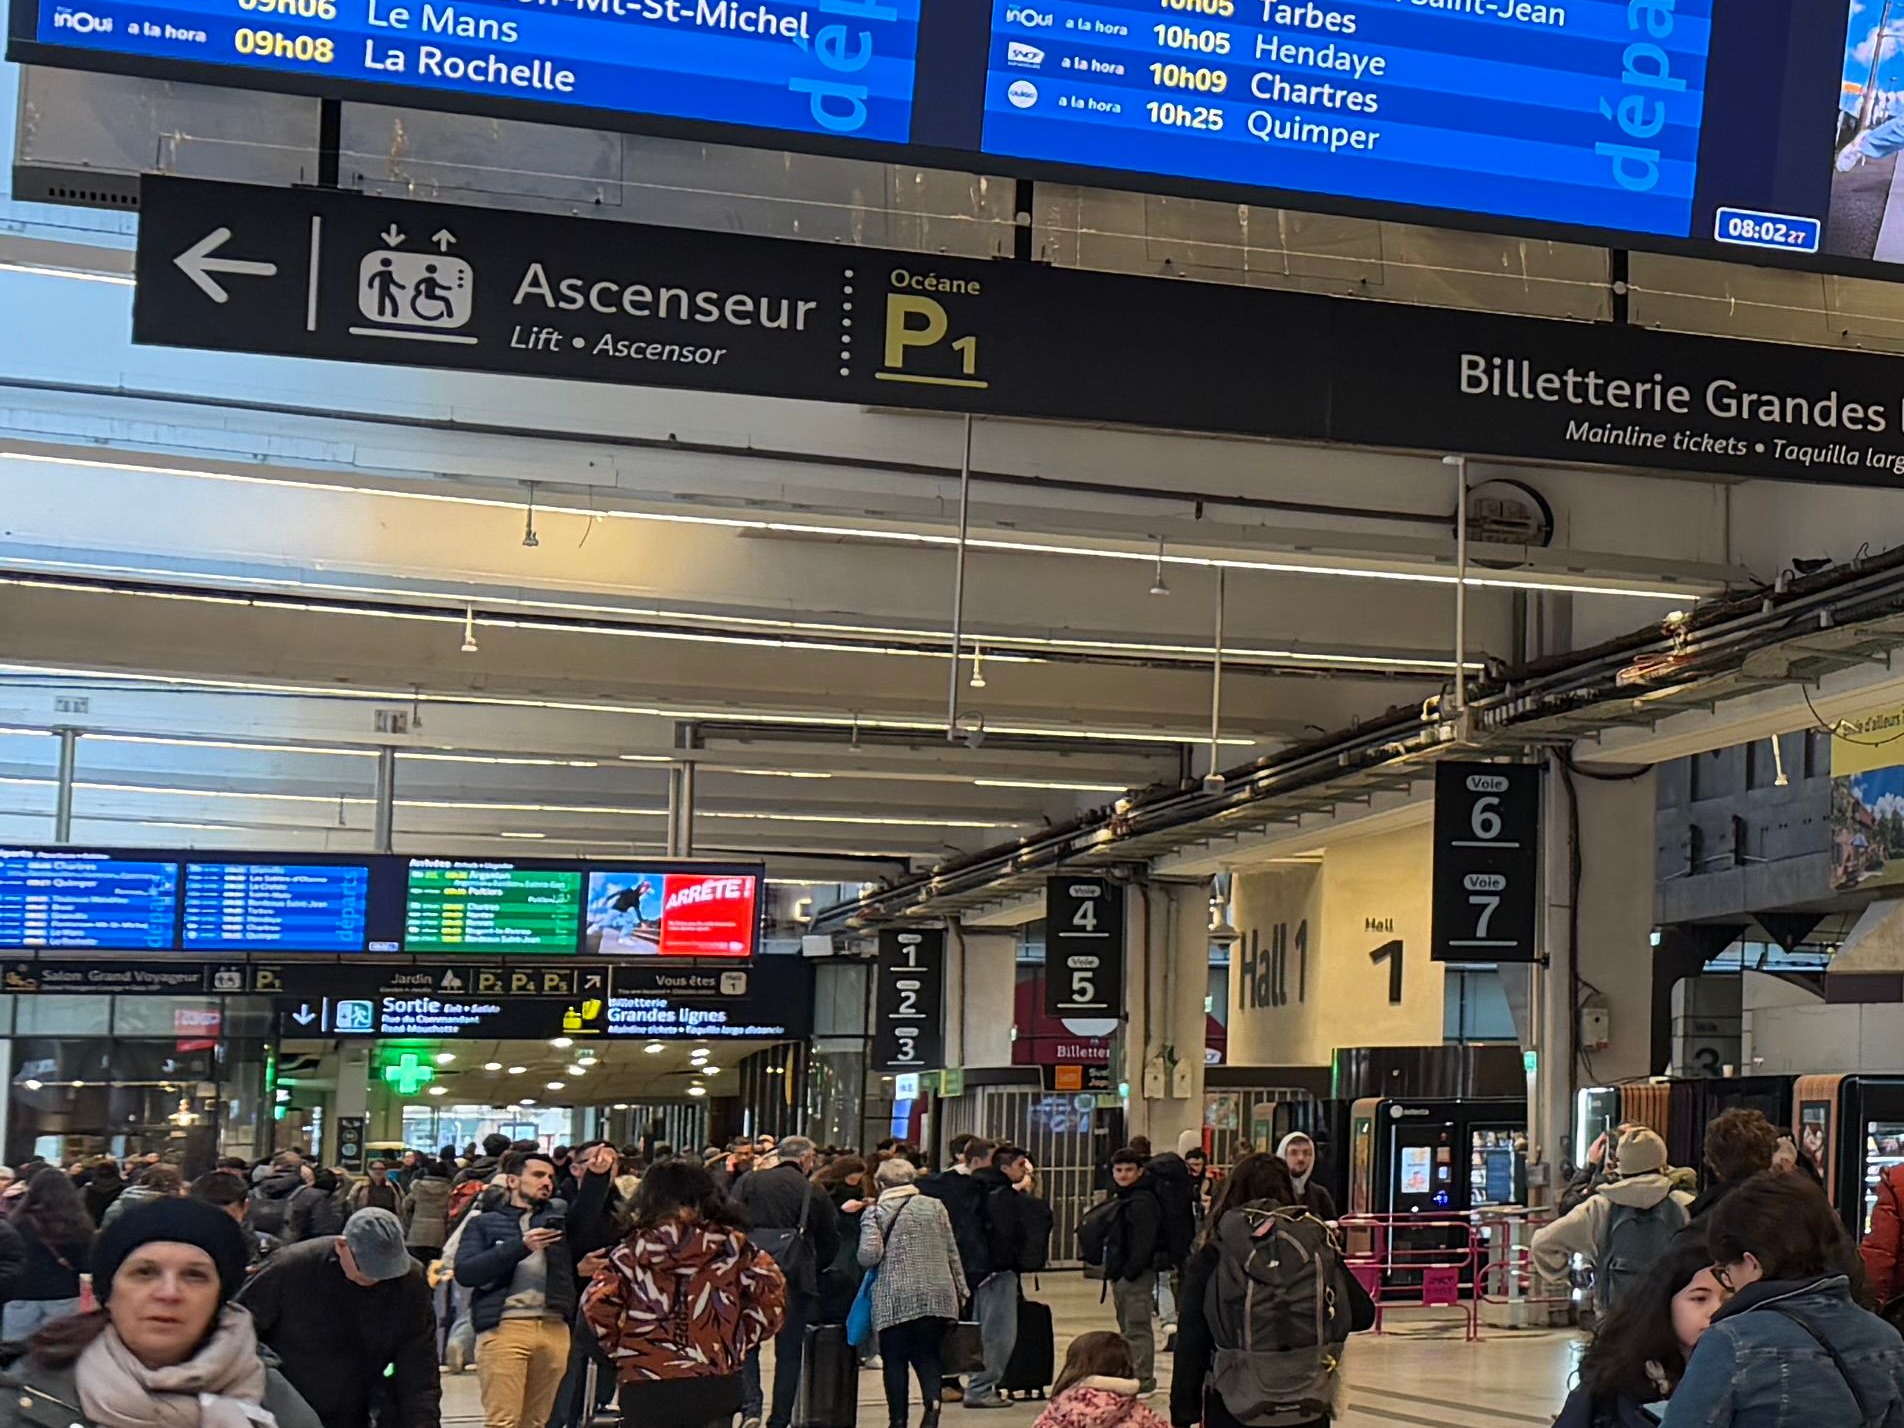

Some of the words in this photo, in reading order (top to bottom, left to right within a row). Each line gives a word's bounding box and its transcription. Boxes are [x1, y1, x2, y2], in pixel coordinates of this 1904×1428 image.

[421, 3, 520, 44] Mans
[234, 27, 335, 64] 09h08
[363, 38, 406, 73] La
[417, 44, 577, 93] Rochelle
[1153, 23, 1232, 56] 10h05
[1254, 33, 1387, 78] Hendaye
[1149, 62, 1228, 94] 10h09
[1249, 71, 1379, 114] Chartres
[1145, 100, 1225, 132] 10h25
[1247, 109, 1381, 153] Quimper
[1728, 218, 1788, 243] 08:02
[512, 262, 817, 332] Ascenseur
[890, 268, 982, 298] Océane
[509, 323, 562, 354] Lift
[591, 332, 727, 367] Ascensor
[1459, 353, 1690, 415] Billetterie
[1705, 378, 1886, 434] Grandes
[1564, 419, 1668, 451] Mainline
[1672, 429, 1749, 457] tickets
[1772, 437, 1860, 472] Taquilla
[1471, 777, 1504, 791] Voie
[1471, 795, 1503, 840] 6
[1468, 875, 1501, 890] Voie
[1072, 899, 1098, 933] 4
[1364, 916, 1395, 933] Hall
[1468, 894, 1501, 939] 7
[902, 945, 916, 967] 1
[1238, 921, 1288, 1012] Hall
[1295, 918, 1309, 1004] 1
[1368, 938, 1404, 1006] 1
[382, 996, 442, 1014] Sortie
[899, 990, 917, 1014] 2
[1070, 971, 1096, 1003] 5
[607, 1007, 677, 1023] Grandes
[679, 1007, 728, 1025] lignes
[896, 1037, 915, 1061] 3
